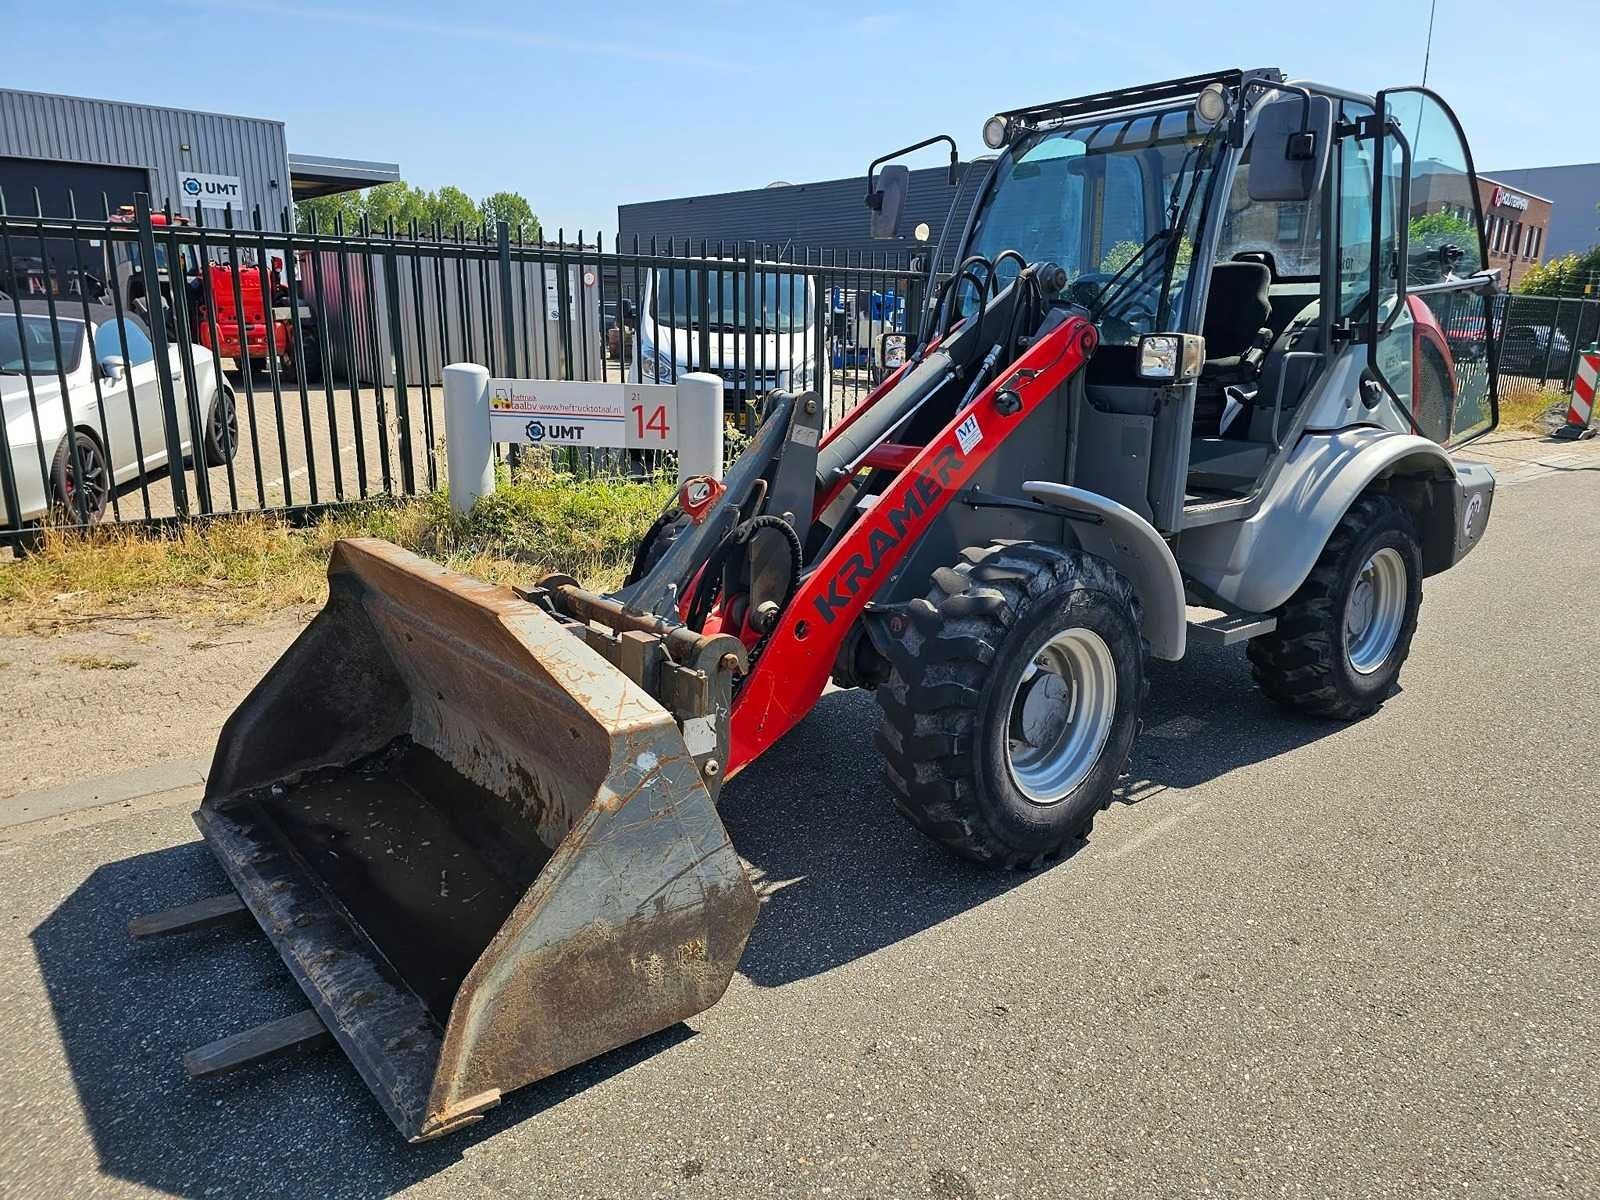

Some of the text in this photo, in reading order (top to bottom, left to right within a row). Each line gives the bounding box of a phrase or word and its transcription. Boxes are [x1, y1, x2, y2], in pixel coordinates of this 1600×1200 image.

[205, 182, 238, 195] UMT
[631, 392, 640, 401] 21
[631, 404, 670, 440] 14
[548, 425, 585, 439] UMT
[813, 444, 966, 624] KRAMER
